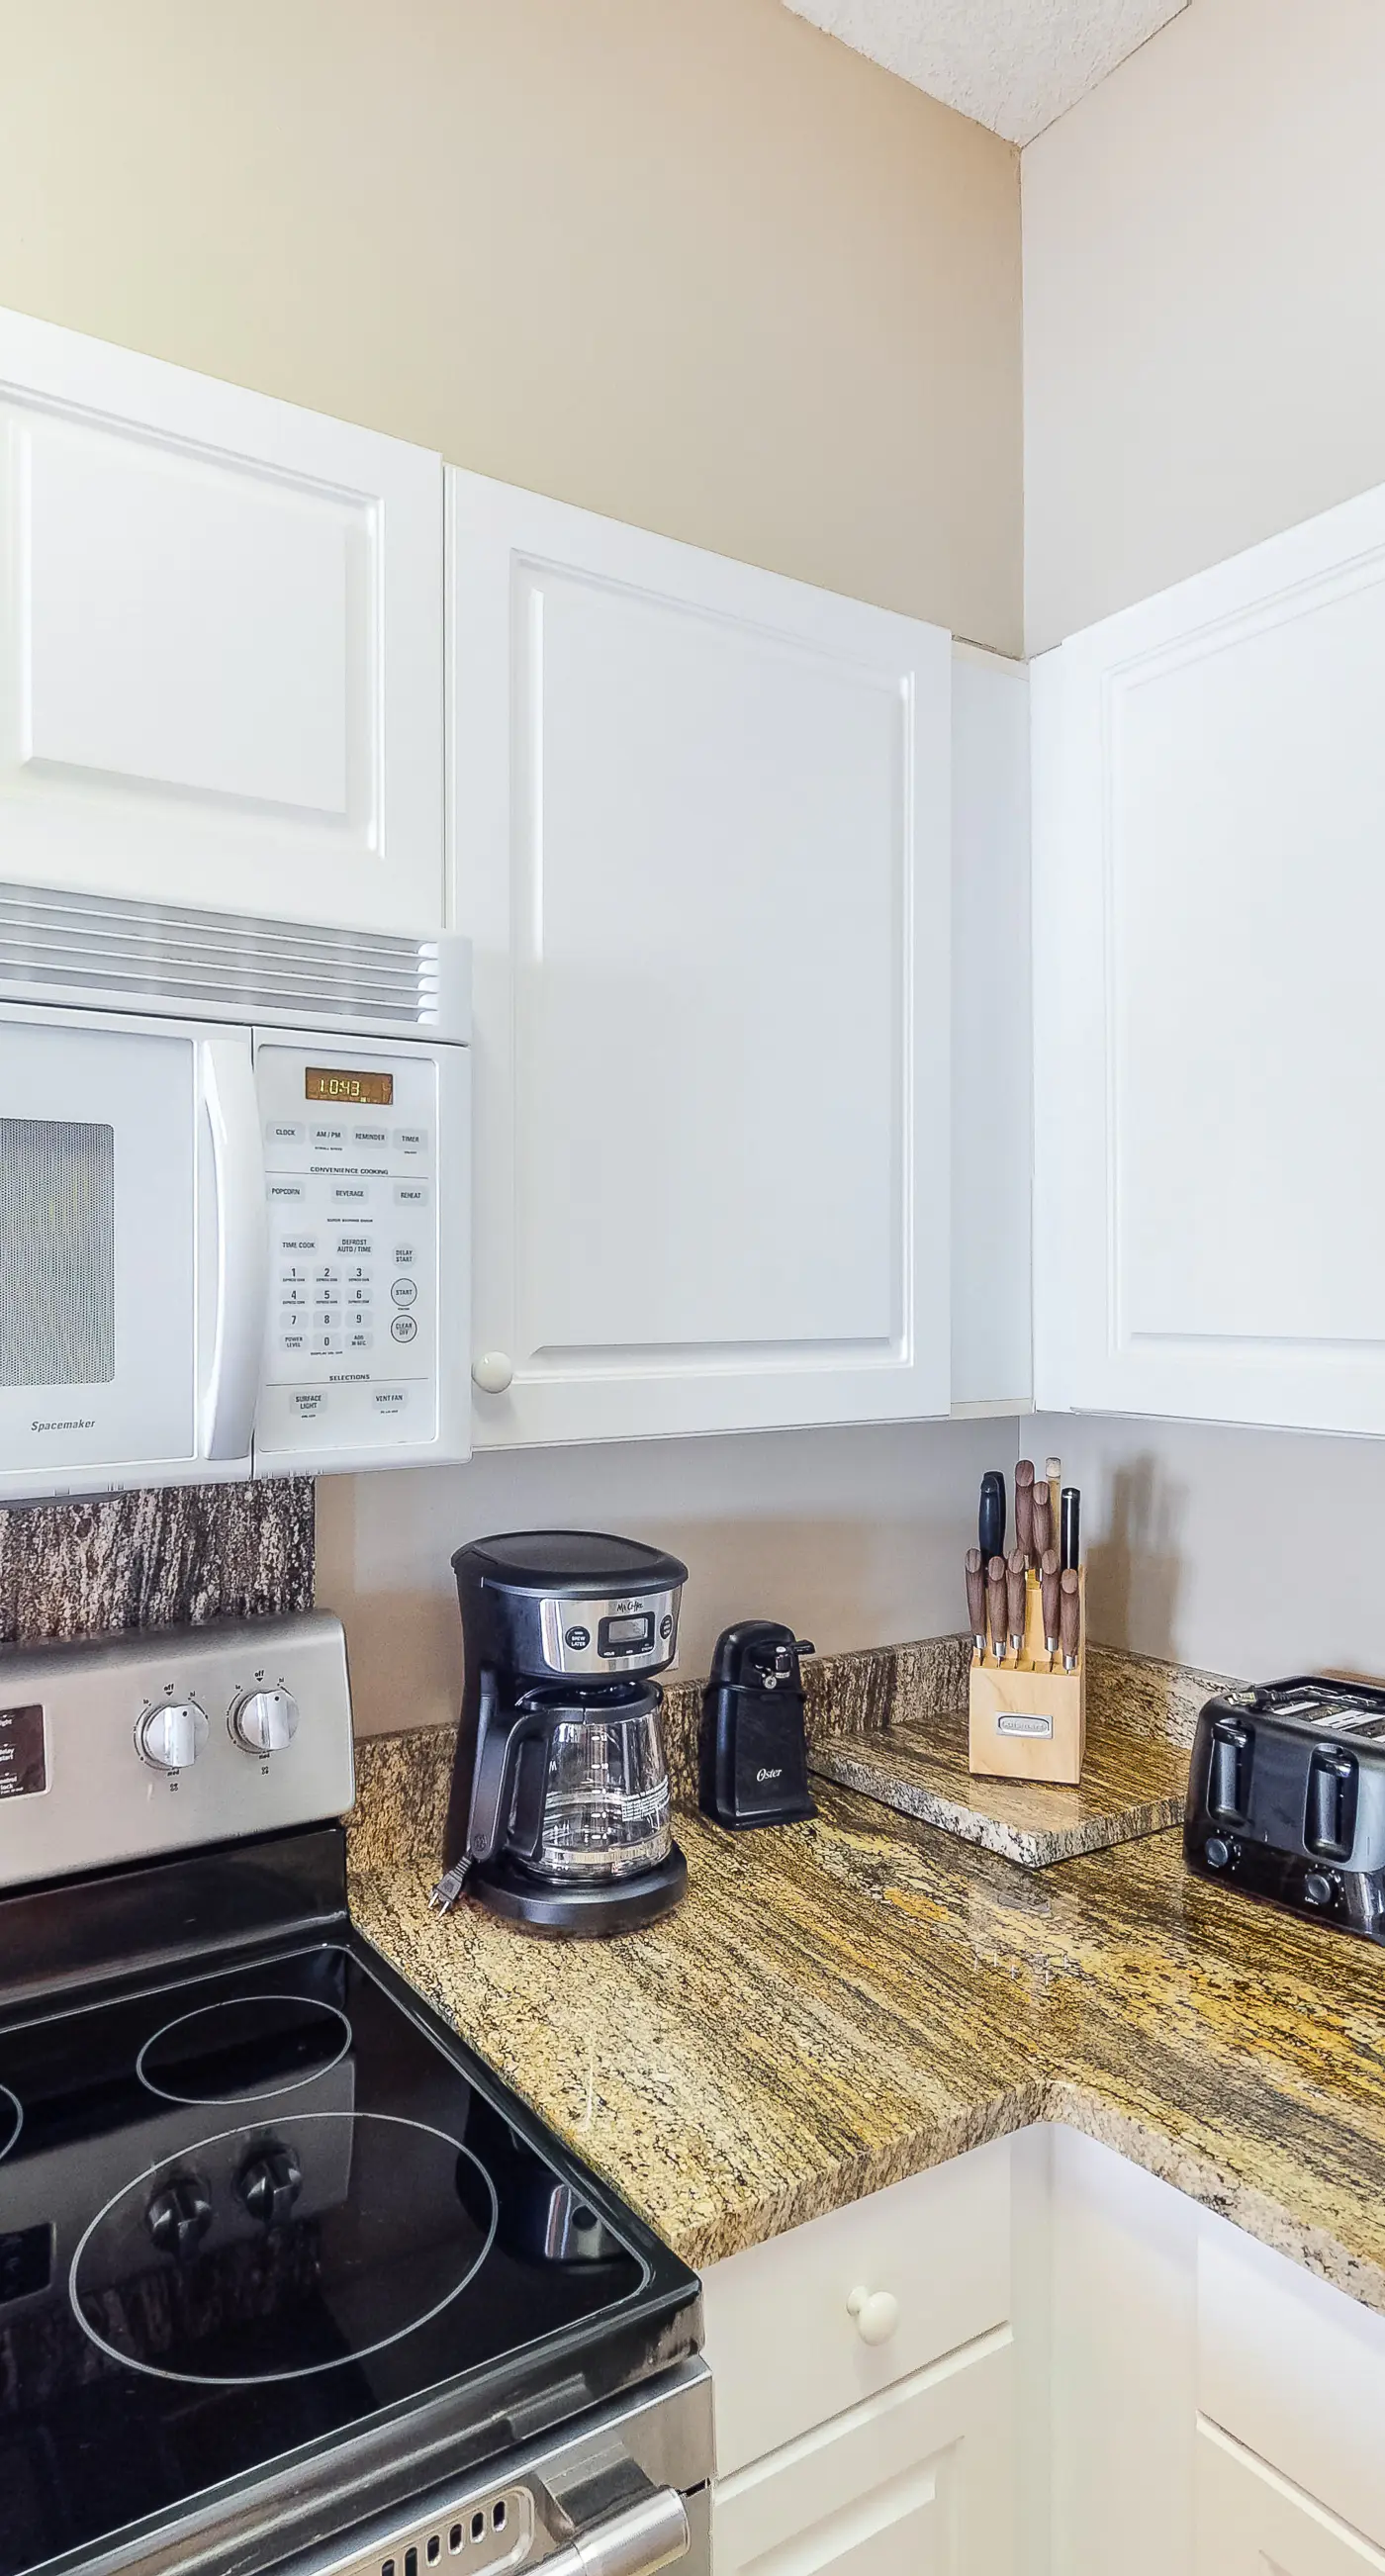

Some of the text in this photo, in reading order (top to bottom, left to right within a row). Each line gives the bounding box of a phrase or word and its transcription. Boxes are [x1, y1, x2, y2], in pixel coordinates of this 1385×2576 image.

[320, 1079, 360, 1096] 10:43
[291, 1268, 296, 1277] 1
[324, 1268, 330, 1277] 2
[356, 1268, 362, 1277] 3
[291, 1290, 297, 1300] 4
[324, 1290, 330, 1299] 5
[356, 1290, 362, 1299] 6
[291, 1316, 297, 1325] 7
[324, 1315, 329, 1324] 8
[356, 1315, 362, 1324] 9
[31, 1419, 96, 1432] Spacemaker
[756, 1768, 783, 1782] Oster
